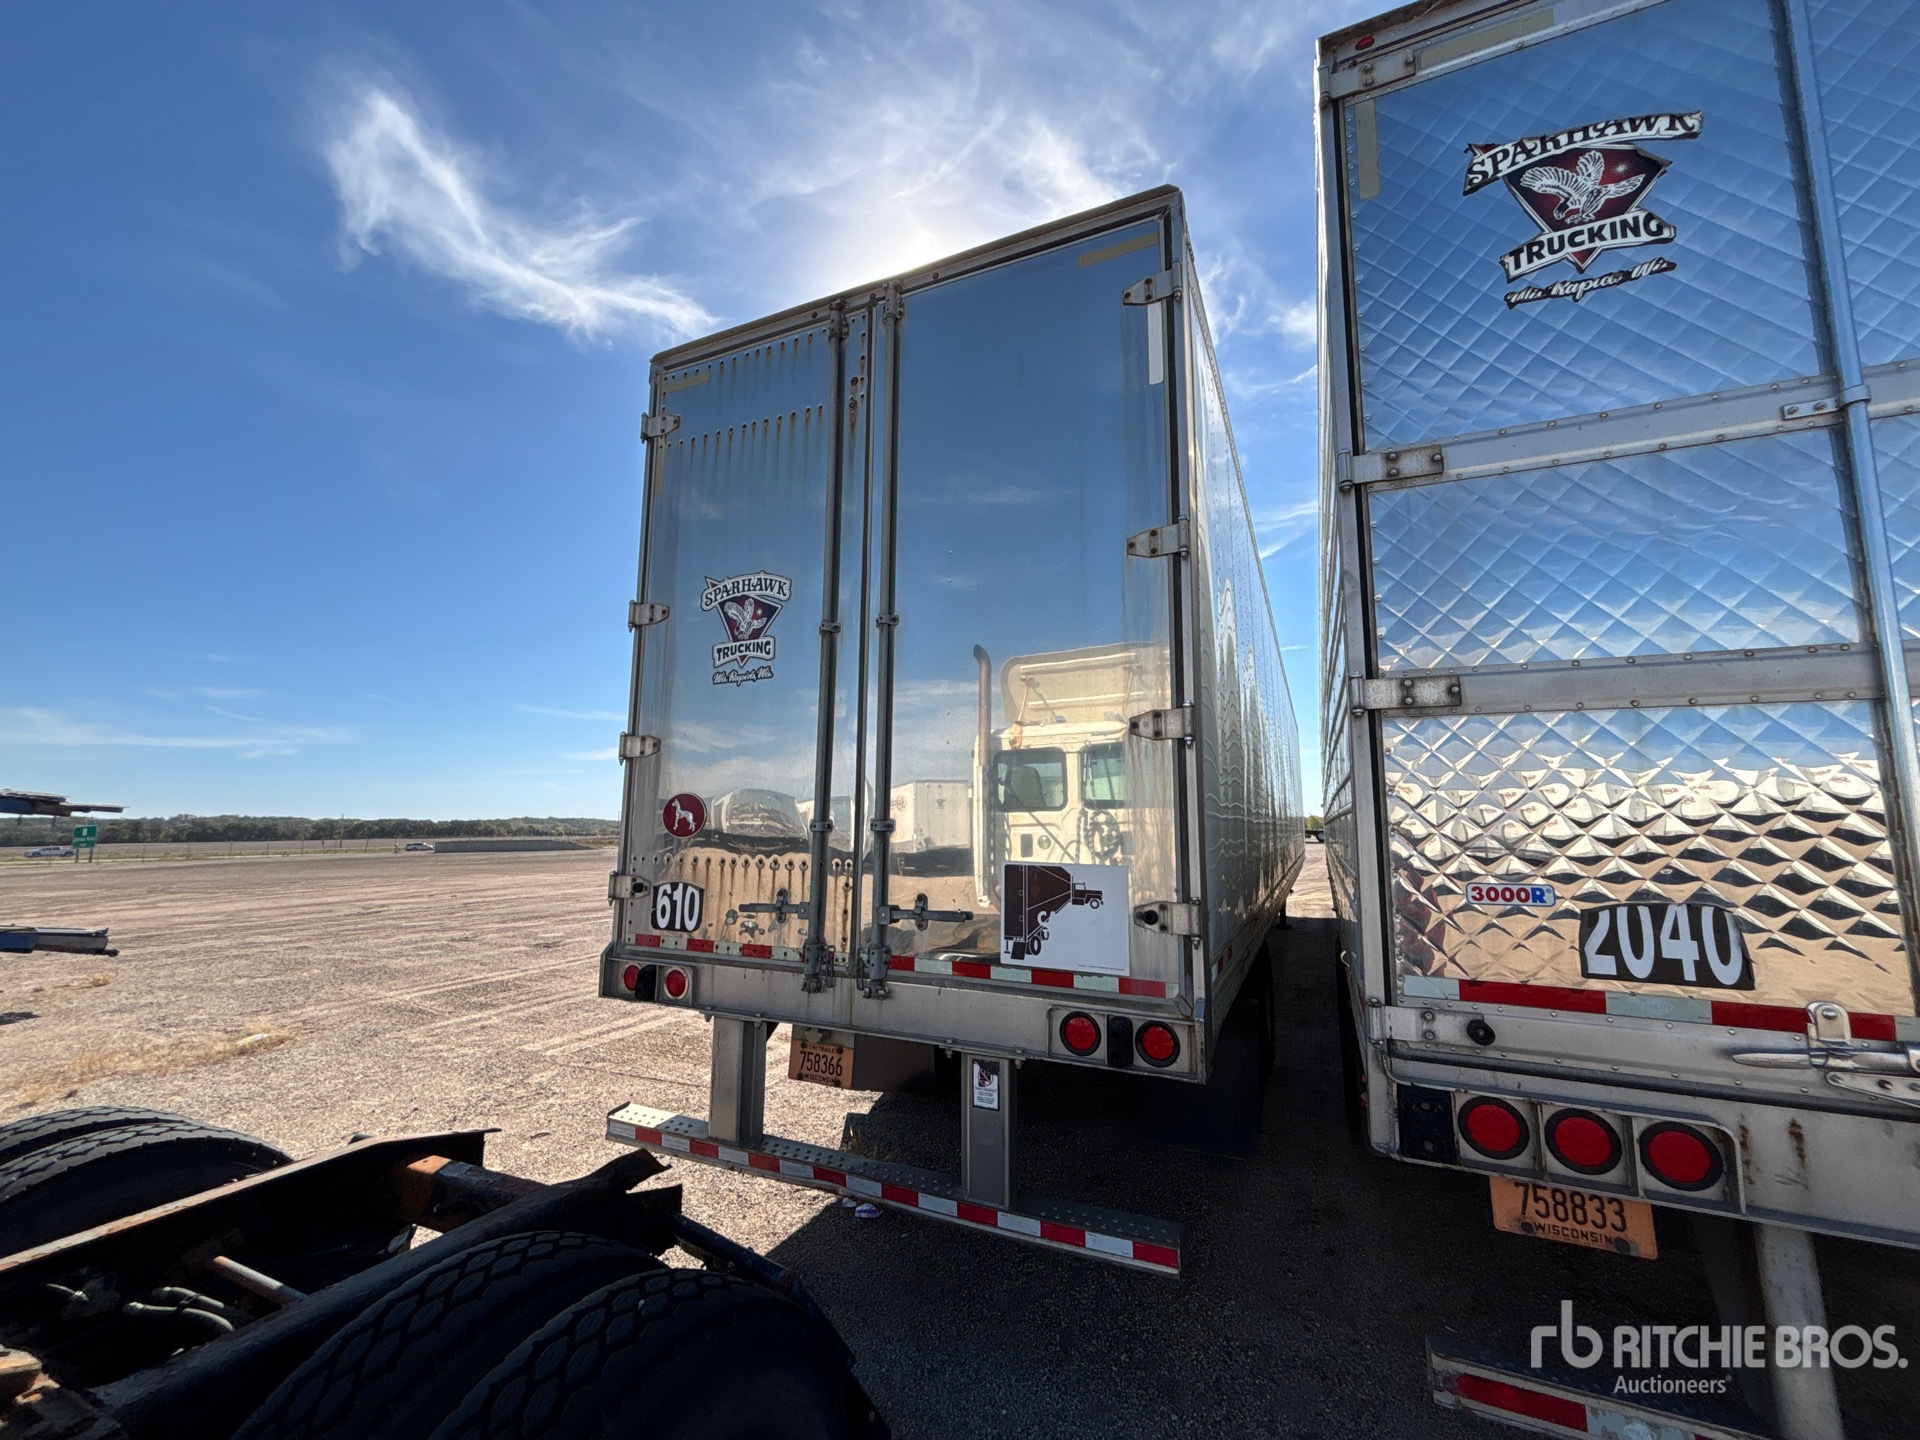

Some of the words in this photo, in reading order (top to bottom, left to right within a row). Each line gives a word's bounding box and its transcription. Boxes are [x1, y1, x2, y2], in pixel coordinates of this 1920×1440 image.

[1508, 212, 1664, 271] TRUCKING
[704, 577, 788, 606] SPARHAWK
[716, 640, 772, 662] TRUCKING
[656, 883, 700, 932] 610
[1584, 905, 1743, 985] 2040
[800, 1050, 843, 1077] 758366
[805, 1073, 835, 1082] WISCONSIN
[1513, 1181, 1627, 1233] 758833
[1534, 1222, 1613, 1246] WISCONSIN
